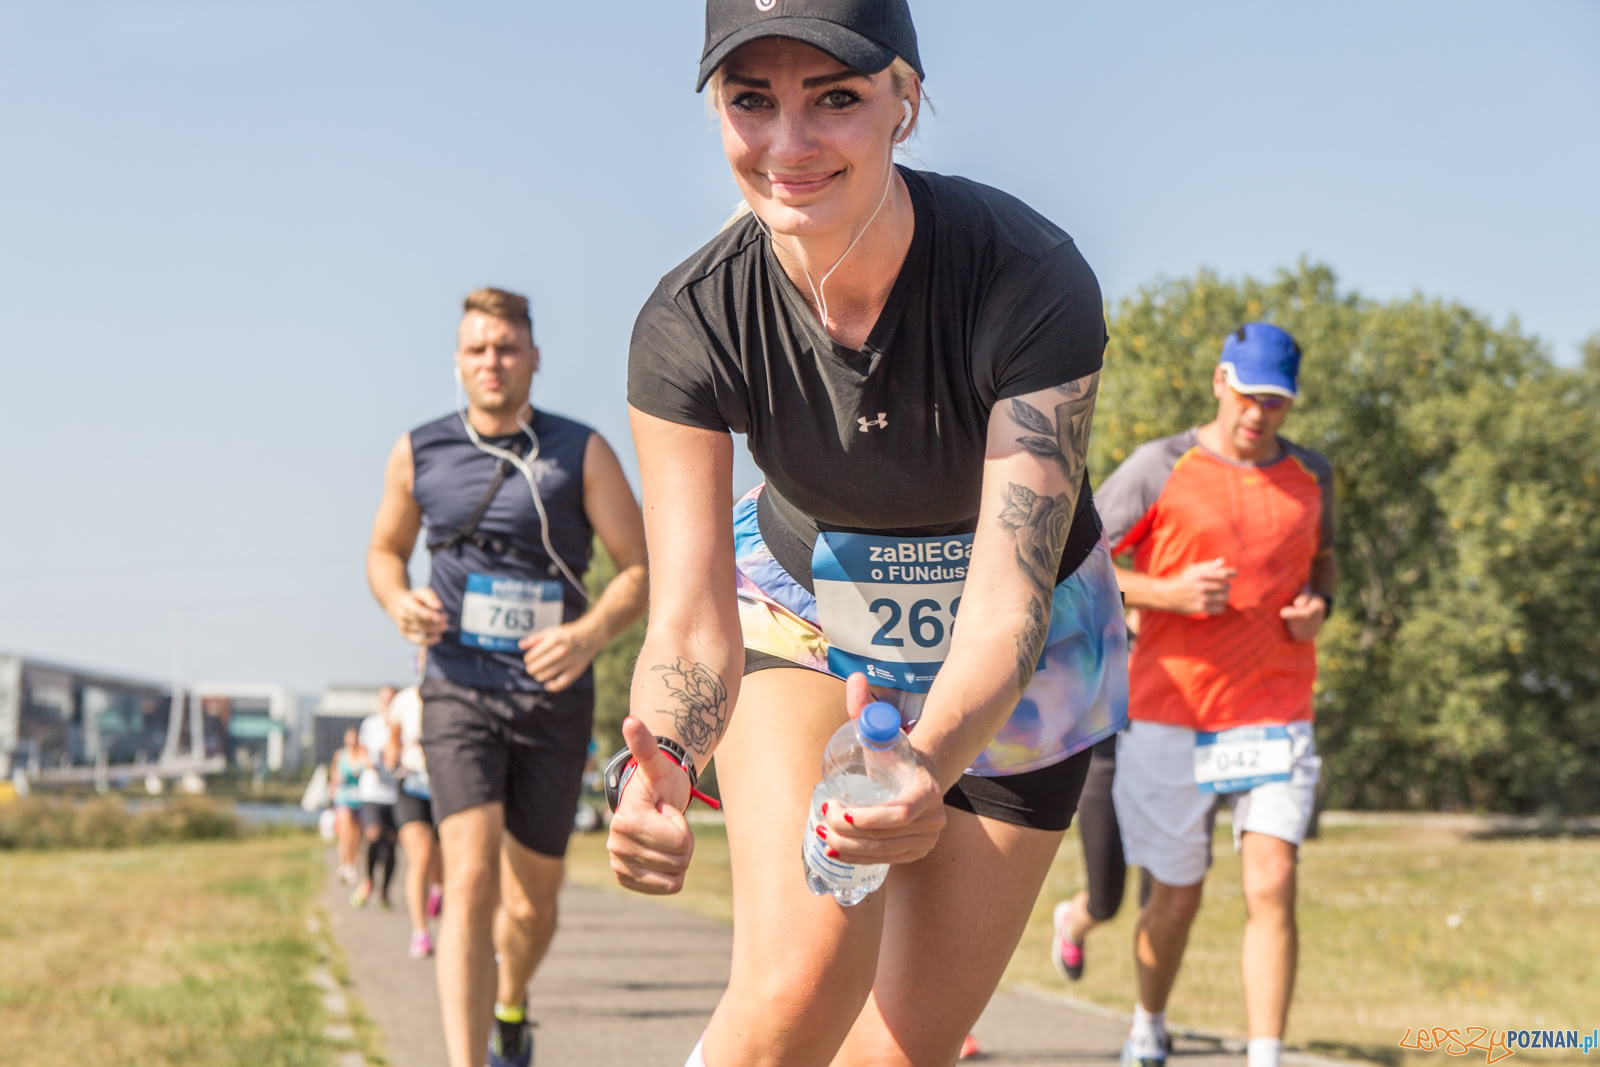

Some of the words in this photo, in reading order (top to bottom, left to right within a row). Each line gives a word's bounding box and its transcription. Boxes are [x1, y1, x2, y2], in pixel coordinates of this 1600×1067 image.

[871, 568, 883, 580] o
[888, 565, 968, 581] FUNdus
[488, 605, 535, 631] 763
